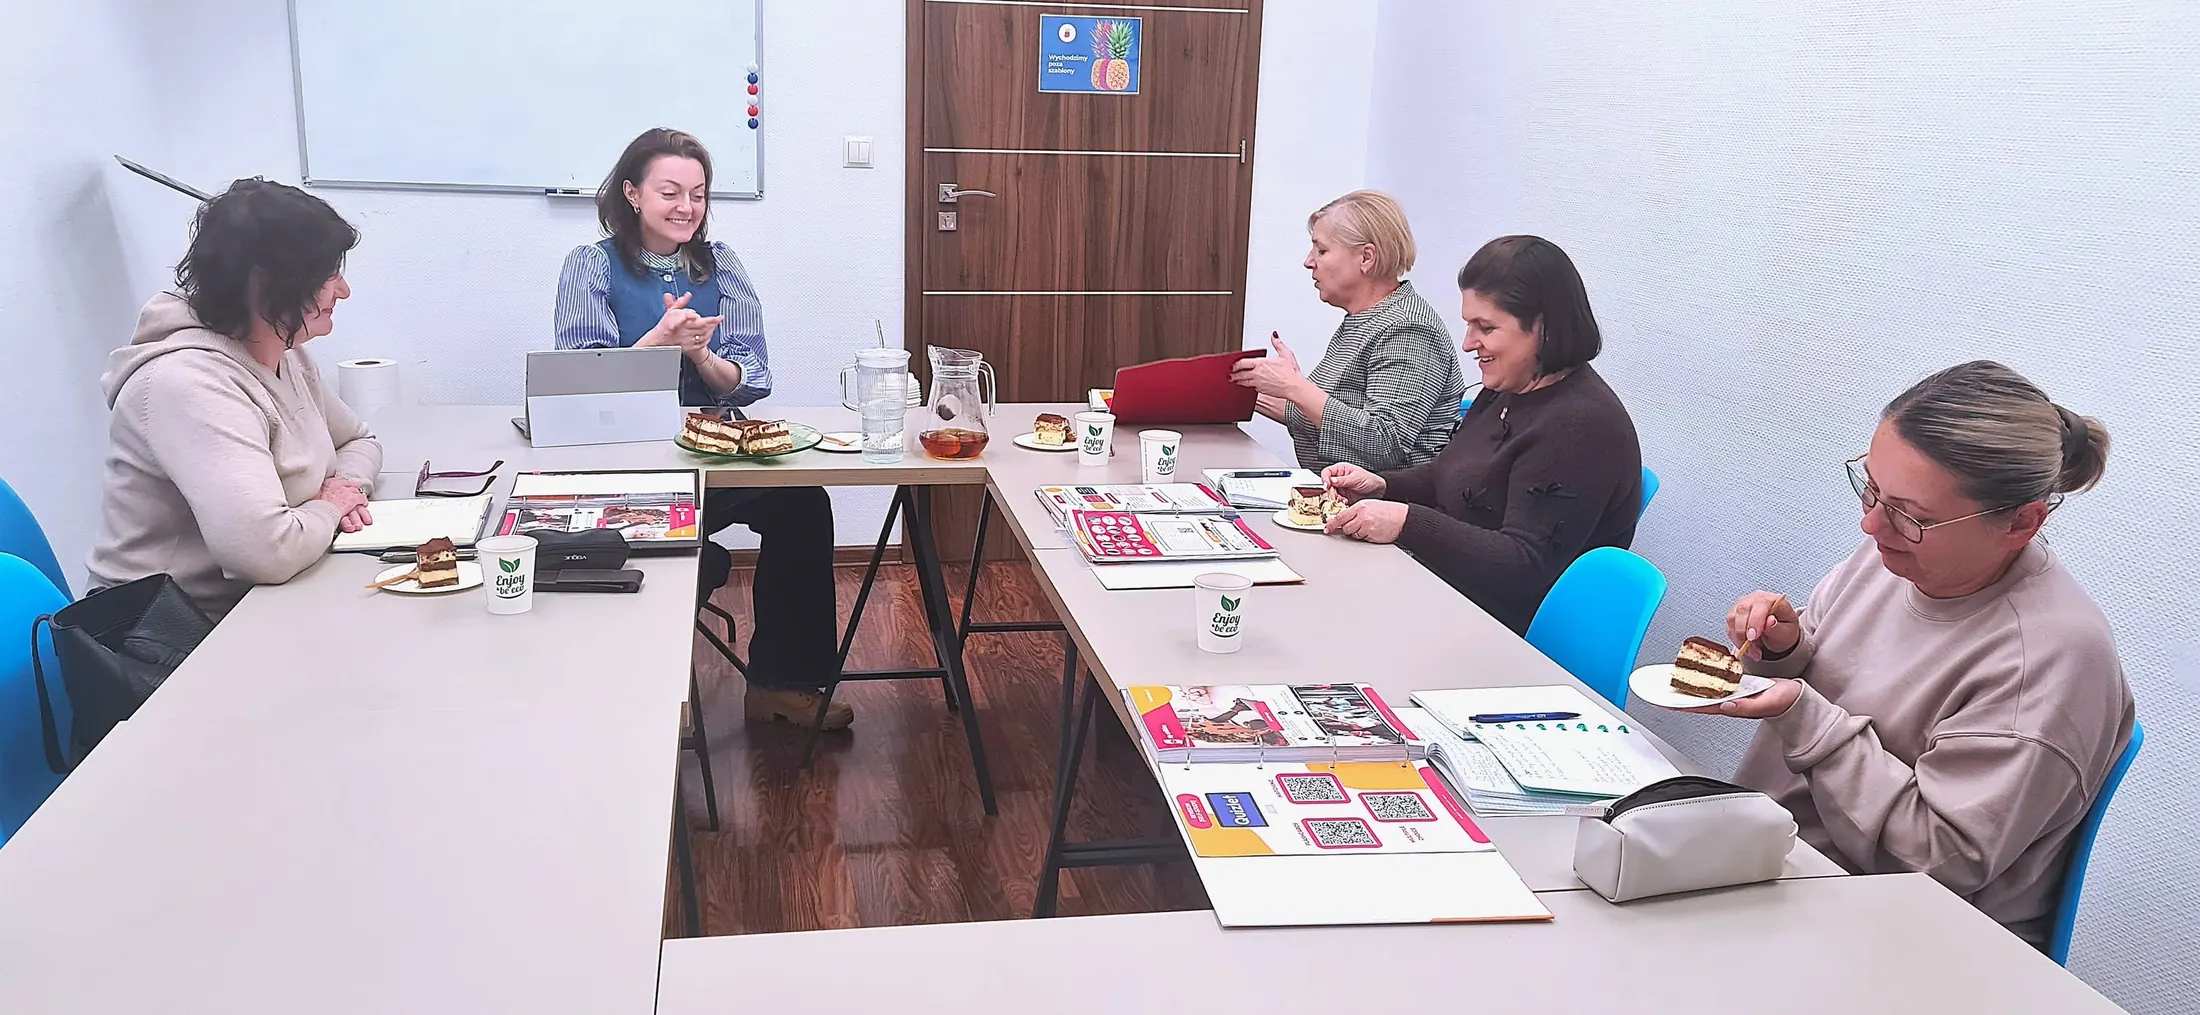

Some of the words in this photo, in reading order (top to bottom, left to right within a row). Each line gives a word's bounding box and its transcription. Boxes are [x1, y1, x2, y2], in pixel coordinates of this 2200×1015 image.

[1048, 54, 1088, 62] Wychodzimy
[1084, 436, 1104, 447] Enjoy
[1157, 457, 1176, 468] Enjoy
[496, 574, 525, 588] Enjoy
[500, 587, 509, 595] be
[511, 585, 525, 594] eco
[1212, 612, 1241, 627] Enjoy
[1214, 624, 1224, 632] be
[1222, 794, 1251, 826] Quizlet
